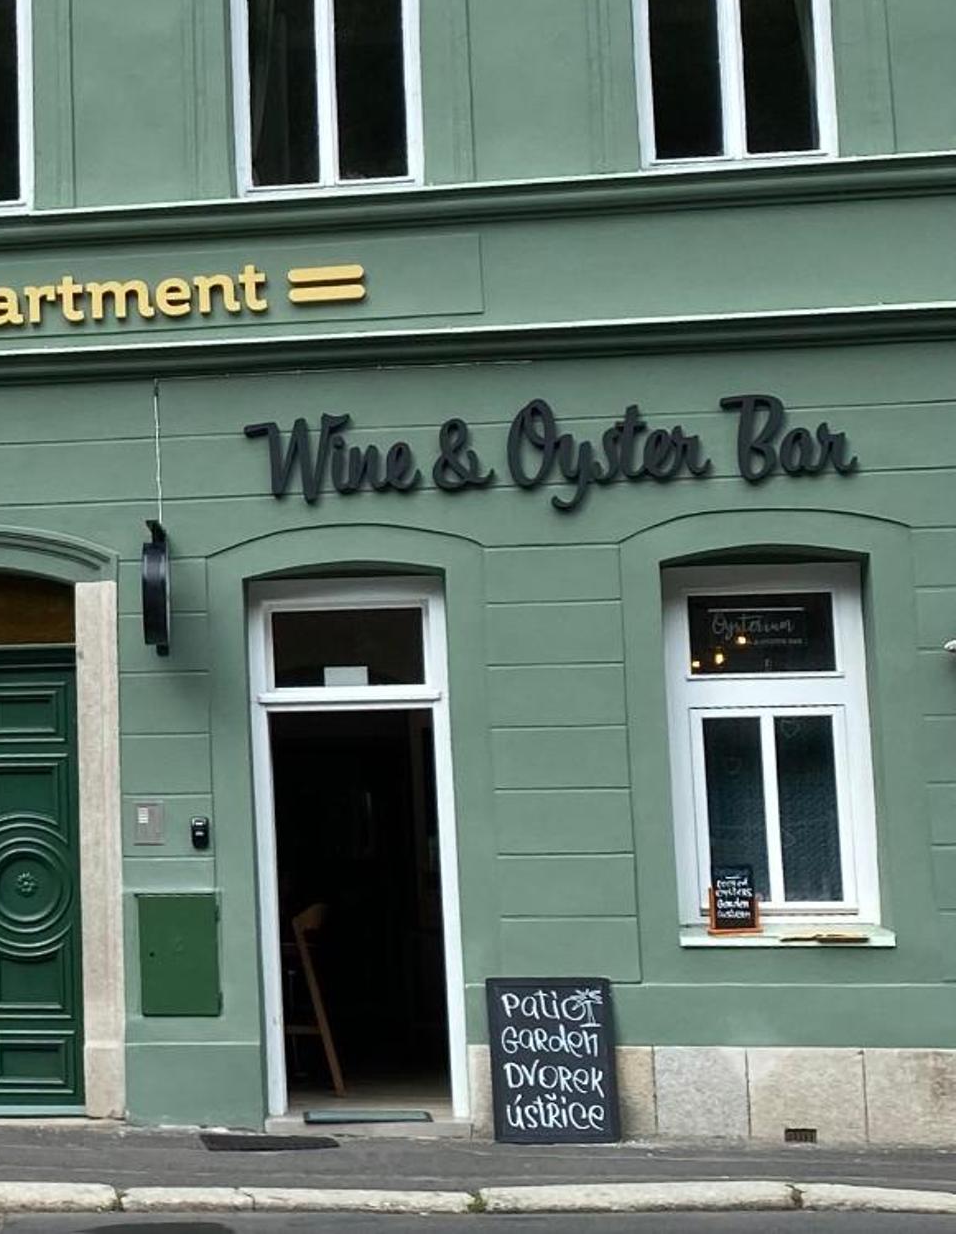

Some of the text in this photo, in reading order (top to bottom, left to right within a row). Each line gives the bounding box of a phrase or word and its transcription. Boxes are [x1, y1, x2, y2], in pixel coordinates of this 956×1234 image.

[245, 394, 858, 511] Wine & Oyster Bar
